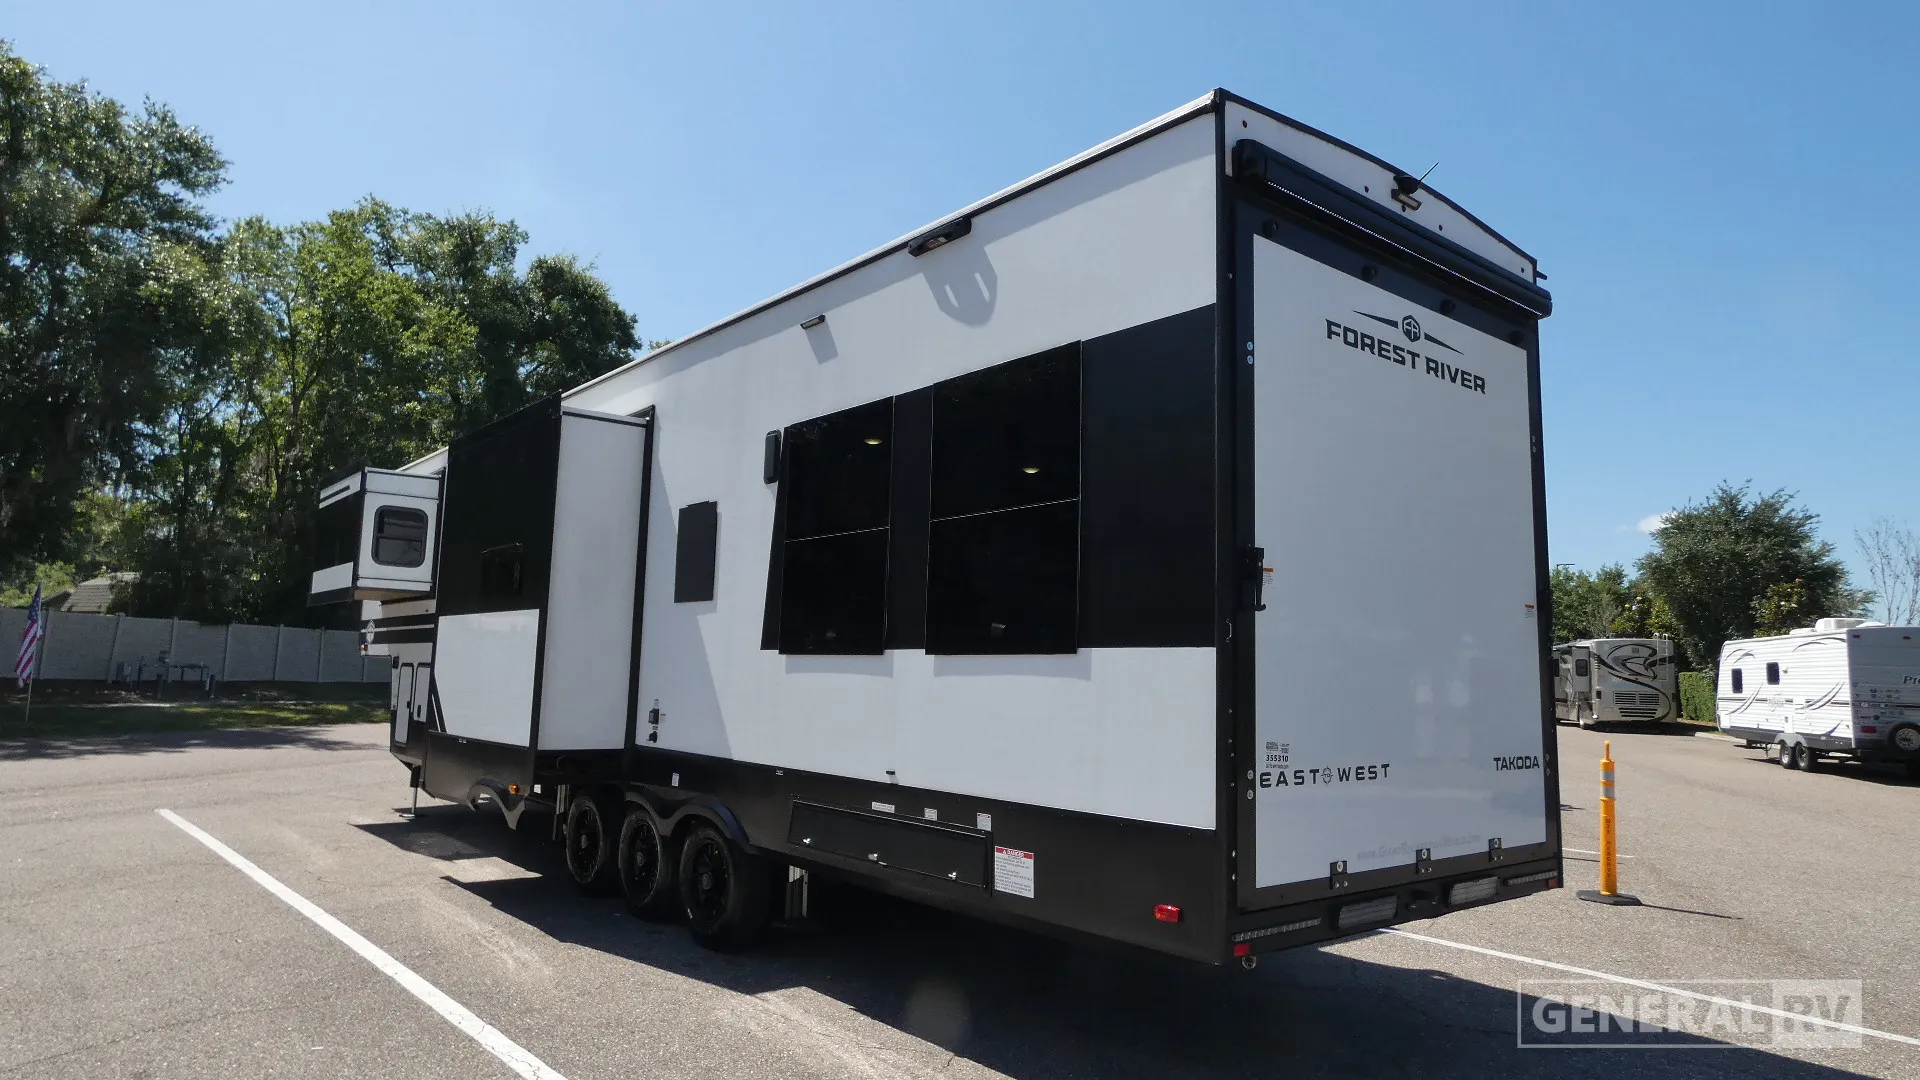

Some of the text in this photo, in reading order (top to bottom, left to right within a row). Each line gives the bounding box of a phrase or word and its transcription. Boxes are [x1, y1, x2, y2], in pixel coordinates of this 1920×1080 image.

[1325, 319, 1486, 394] FOREST RIVER
[1265, 754, 1289, 762] 355310
[1493, 755, 1540, 771] TAKODA
[1260, 768, 1320, 788] EAST
[1337, 763, 1389, 782] WEST
